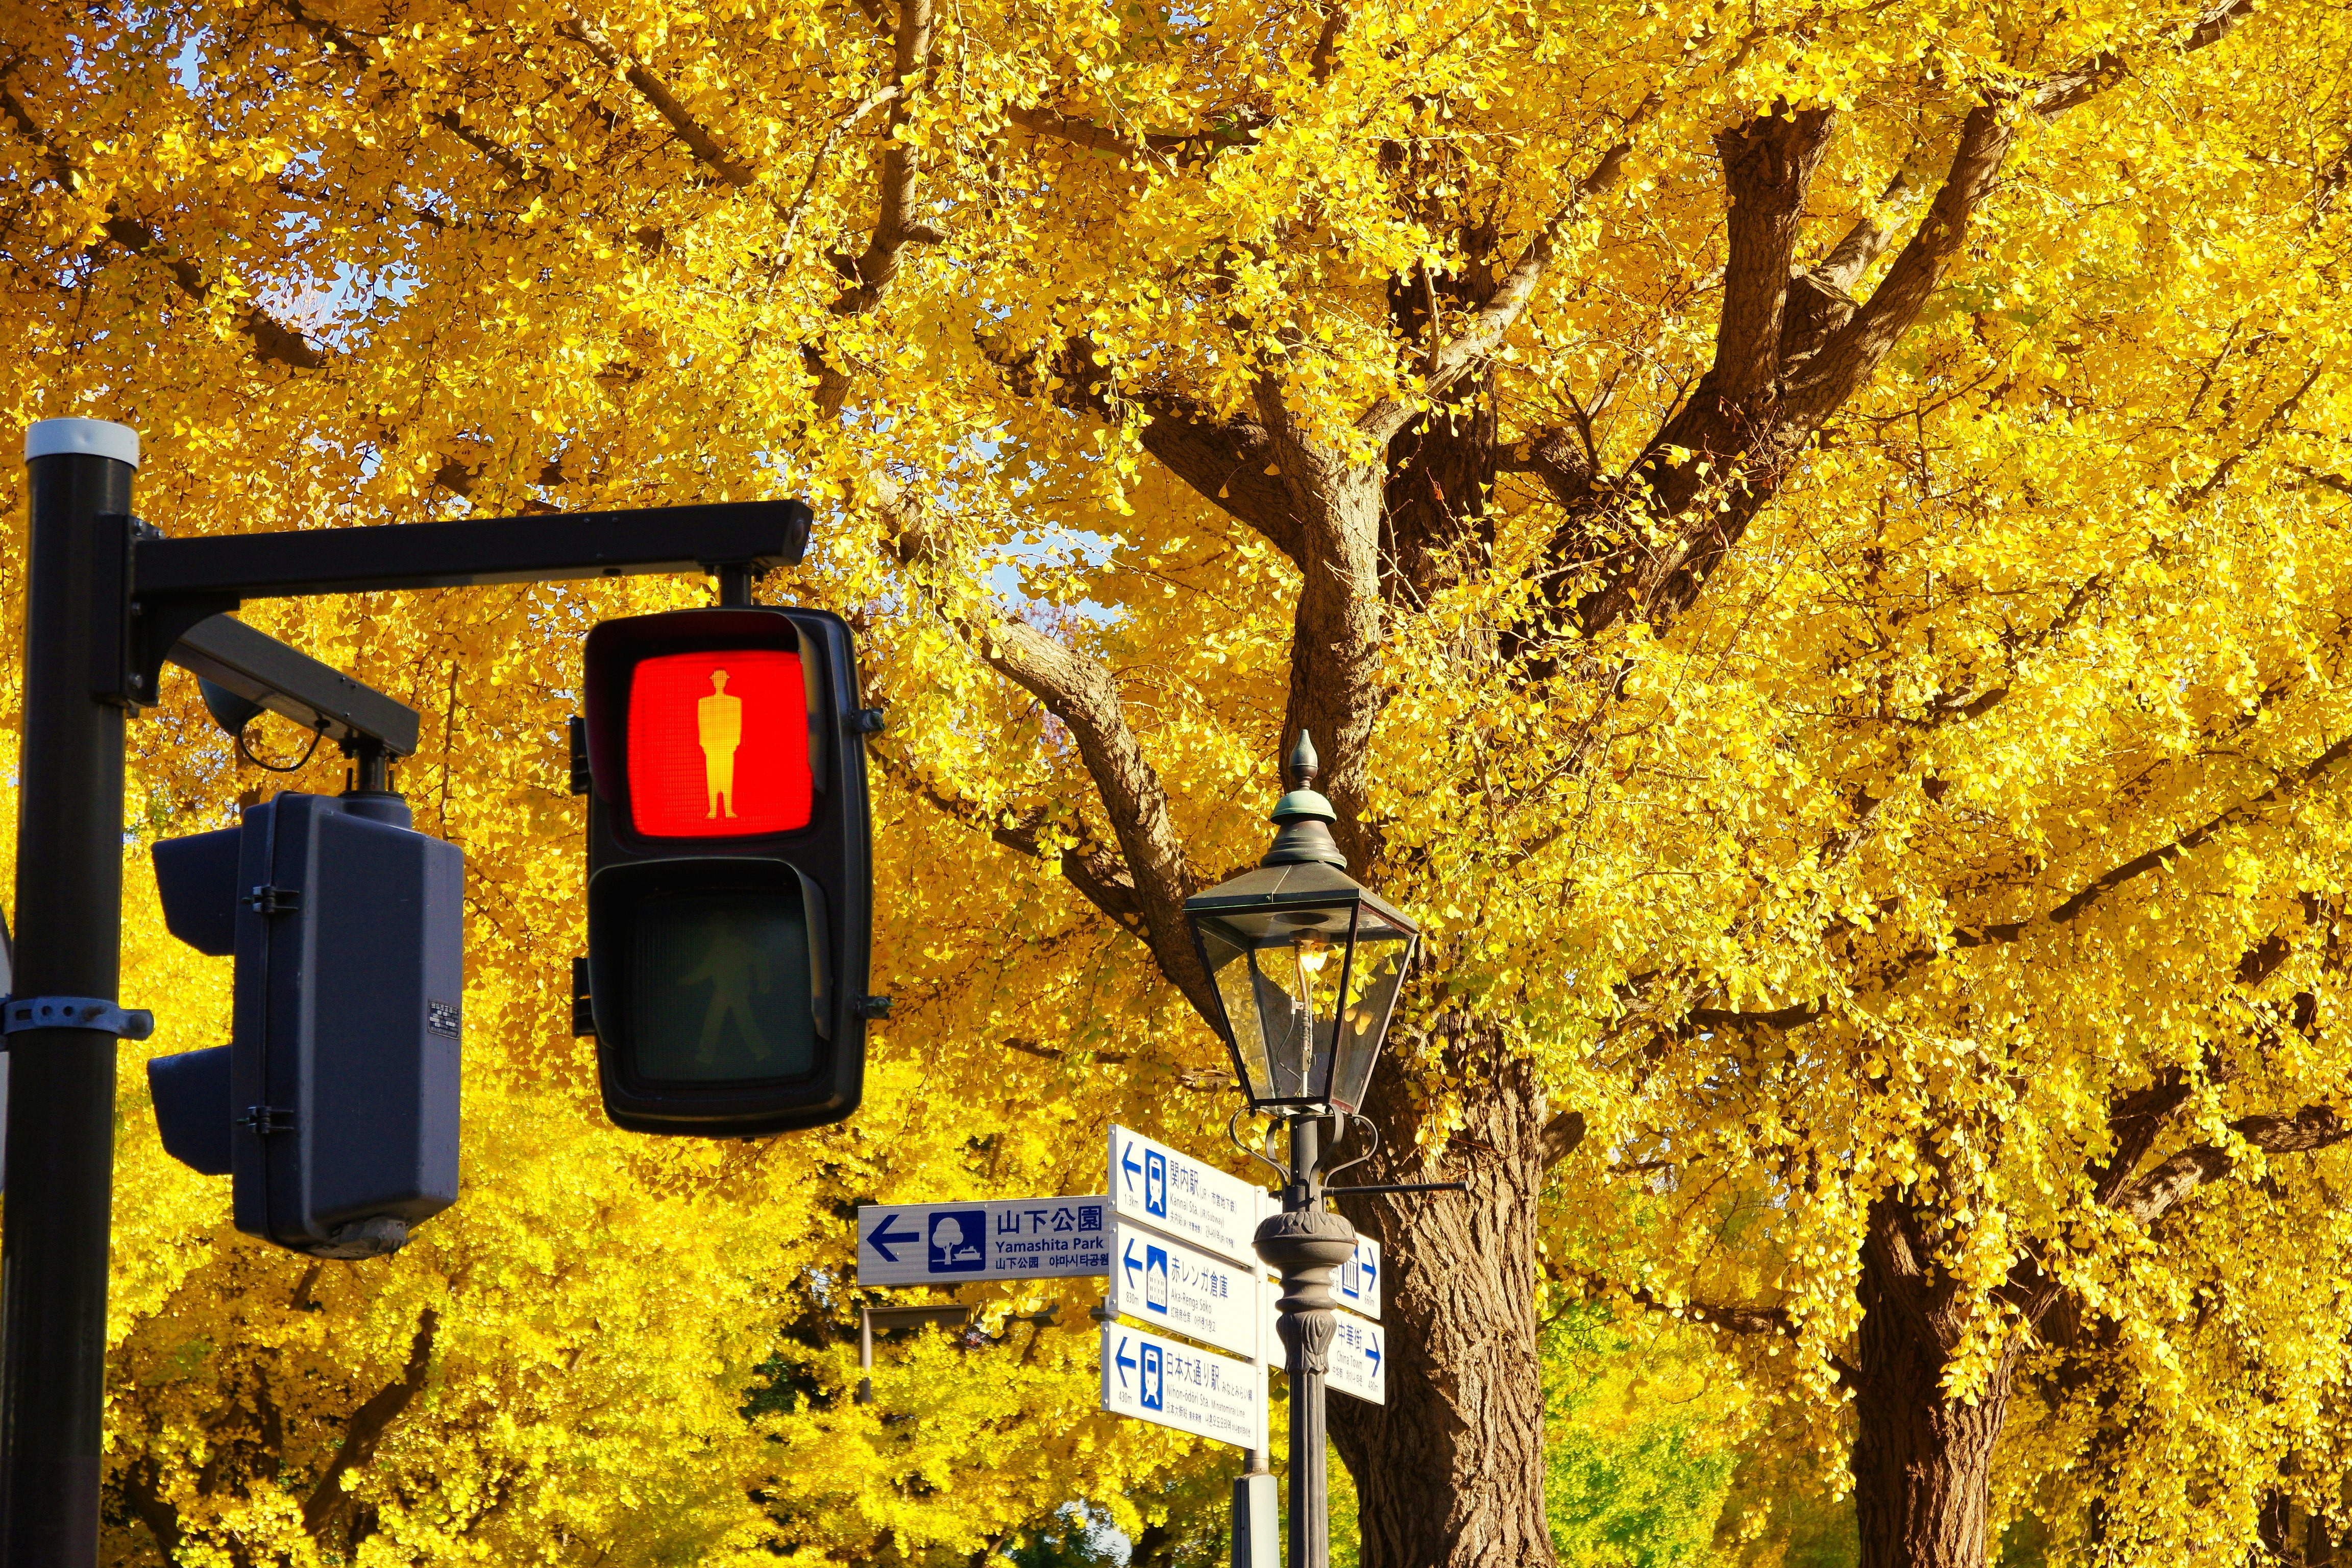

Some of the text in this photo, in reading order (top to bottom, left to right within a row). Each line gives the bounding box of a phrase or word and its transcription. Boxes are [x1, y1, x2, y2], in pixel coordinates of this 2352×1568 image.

[1124, 1193, 1139, 1209] 1.3km
[1170, 1193, 1188, 1211] Kannai
[1189, 1201, 1198, 1216] Sta.
[997, 1205, 1102, 1235] 山下公園
[995, 1236, 1104, 1253] Yamashita Park
[996, 1256, 1039, 1270] 山下公园
[1049, 1253, 1109, 1268] 야마시타공원
[1171, 1255, 1228, 1301] 赤レンガ倉庫
[1126, 1291, 1139, 1306] 830m
[1171, 1288, 1198, 1311] Aka-Renga
[1338, 1320, 1362, 1353] 中華街
[1337, 1351, 1362, 1370] China Town
[1167, 1353, 1220, 1392] 日本大通り駅
[1368, 1380, 1379, 1392] 490m
[1119, 1390, 1132, 1405] 430m
[1200, 1393, 1210, 1408] Sta.
[1211, 1400, 1236, 1415] Minatomirai
[1236, 1406, 1245, 1418] Line
